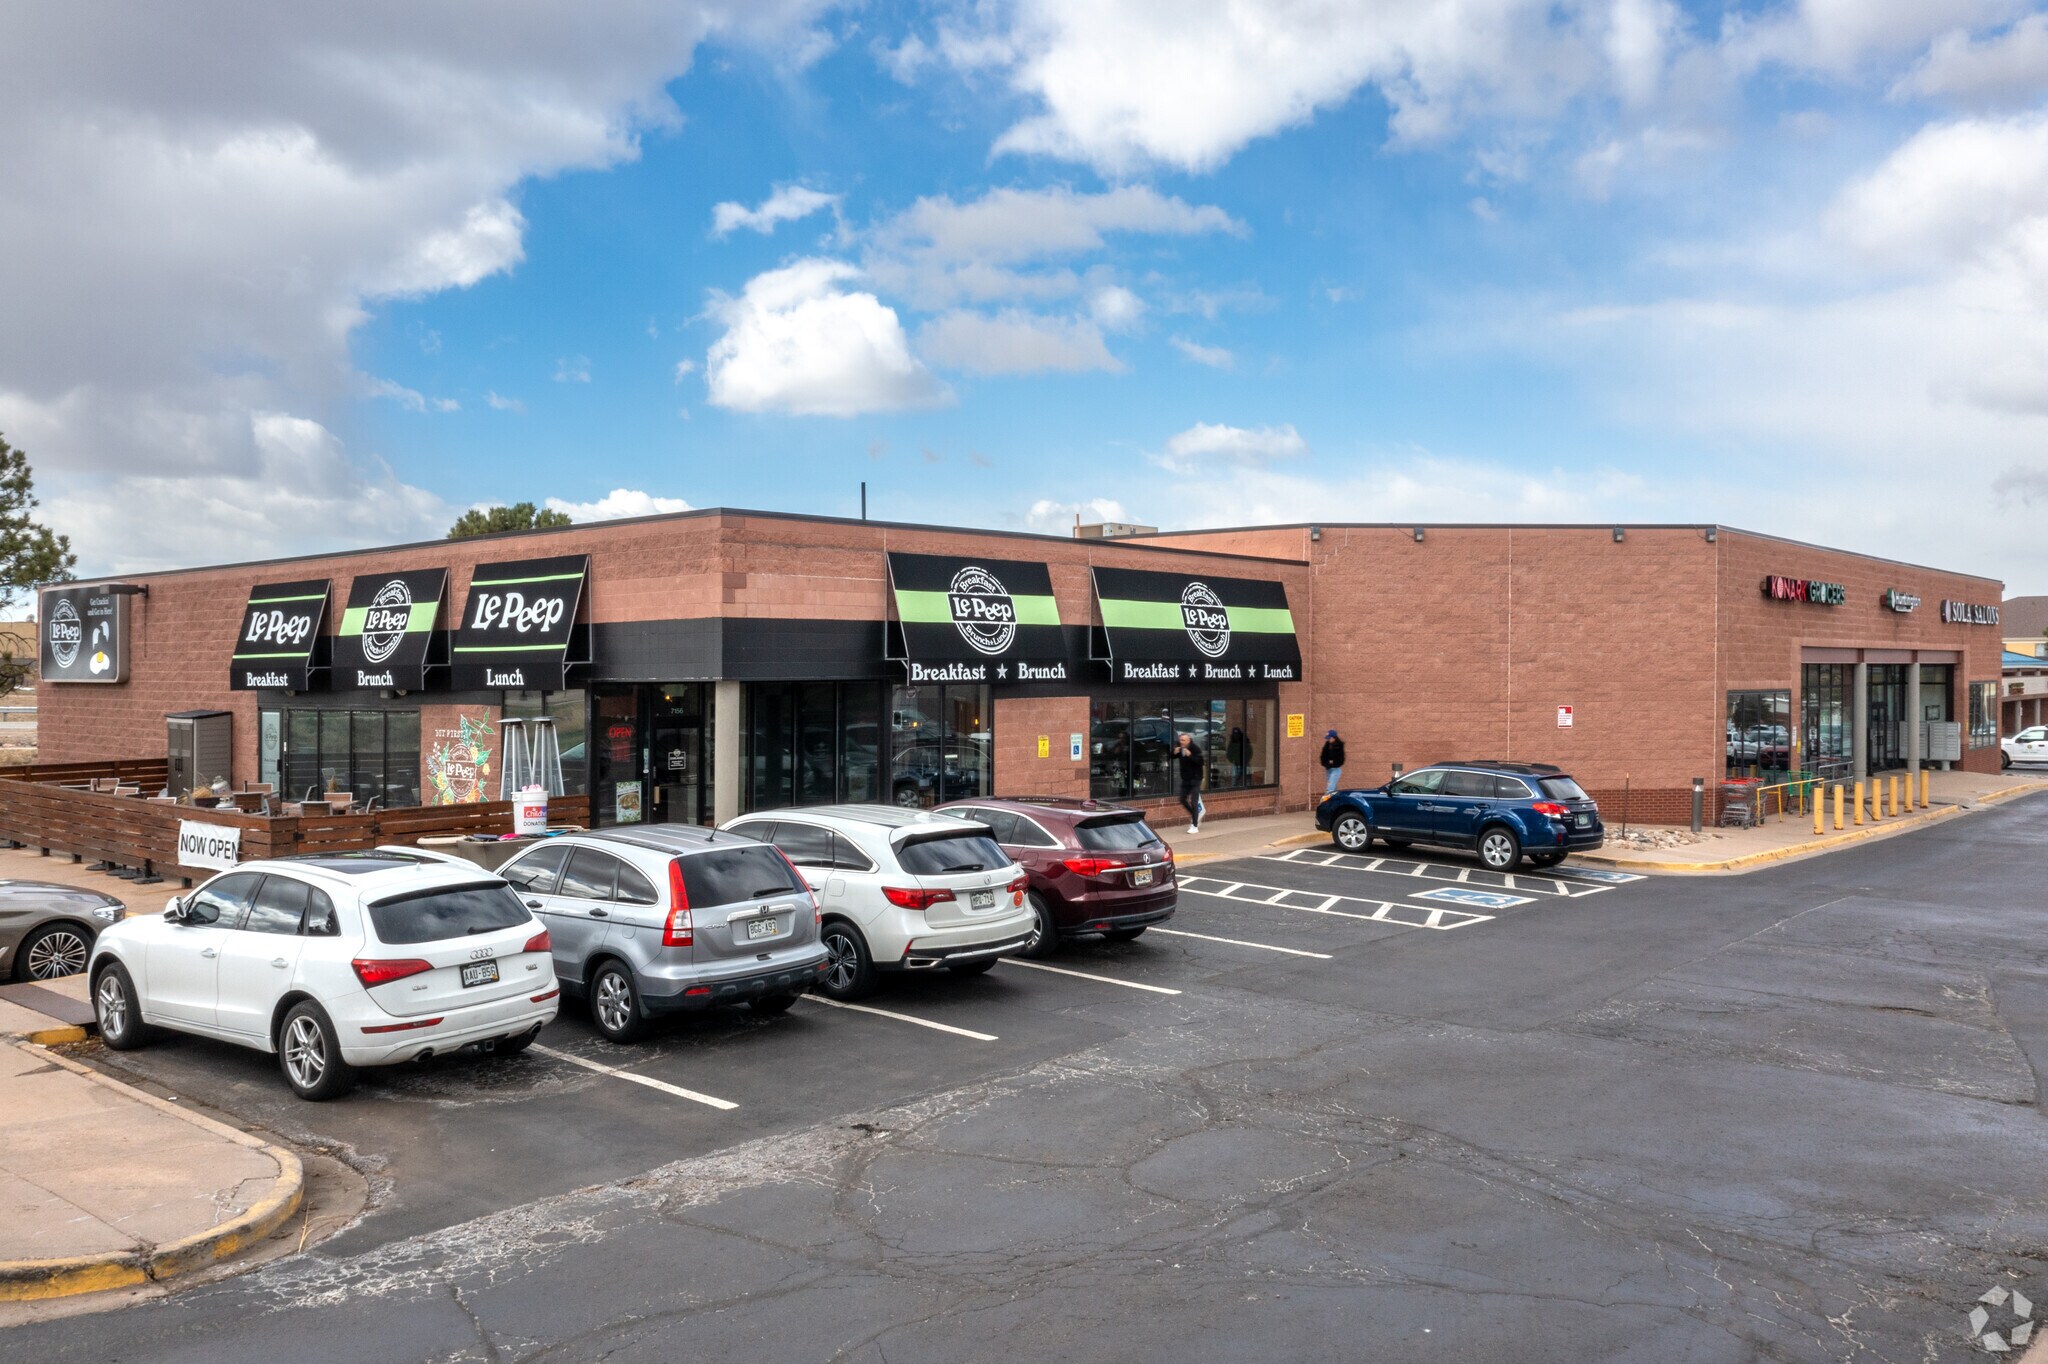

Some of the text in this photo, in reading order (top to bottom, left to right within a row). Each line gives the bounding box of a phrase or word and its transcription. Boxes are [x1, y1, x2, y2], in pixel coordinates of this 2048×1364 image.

[959, 575, 996, 593] Breakfast
[1771, 576, 1845, 605] KONARK GROCERS
[1188, 590, 1214, 604] Breakfast
[471, 592, 564, 632] Le Peep
[952, 597, 1012, 621] Le Peep
[1184, 608, 1227, 628] Le Peep
[1952, 602, 1998, 624] SOLA SALONS
[245, 610, 311, 644] Le Peep
[366, 610, 407, 630] Le Peep
[52, 623, 79, 640] Le Peep
[966, 625, 1009, 645] Brunch Lunch
[381, 636, 398, 653] Lunch
[1214, 634, 1226, 649] Lunch
[246, 672, 288, 686] Breakfast
[357, 670, 393, 686] Brunch
[486, 668, 524, 686] Lunch
[911, 663, 1066, 681] Breakfast Brunch
[1124, 663, 1293, 678] Breakfast Brunch Lunch
[609, 727, 632, 738] OPEN
[446, 763, 475, 778] Le Peep
[181, 834, 238, 861] NOW OPEN
